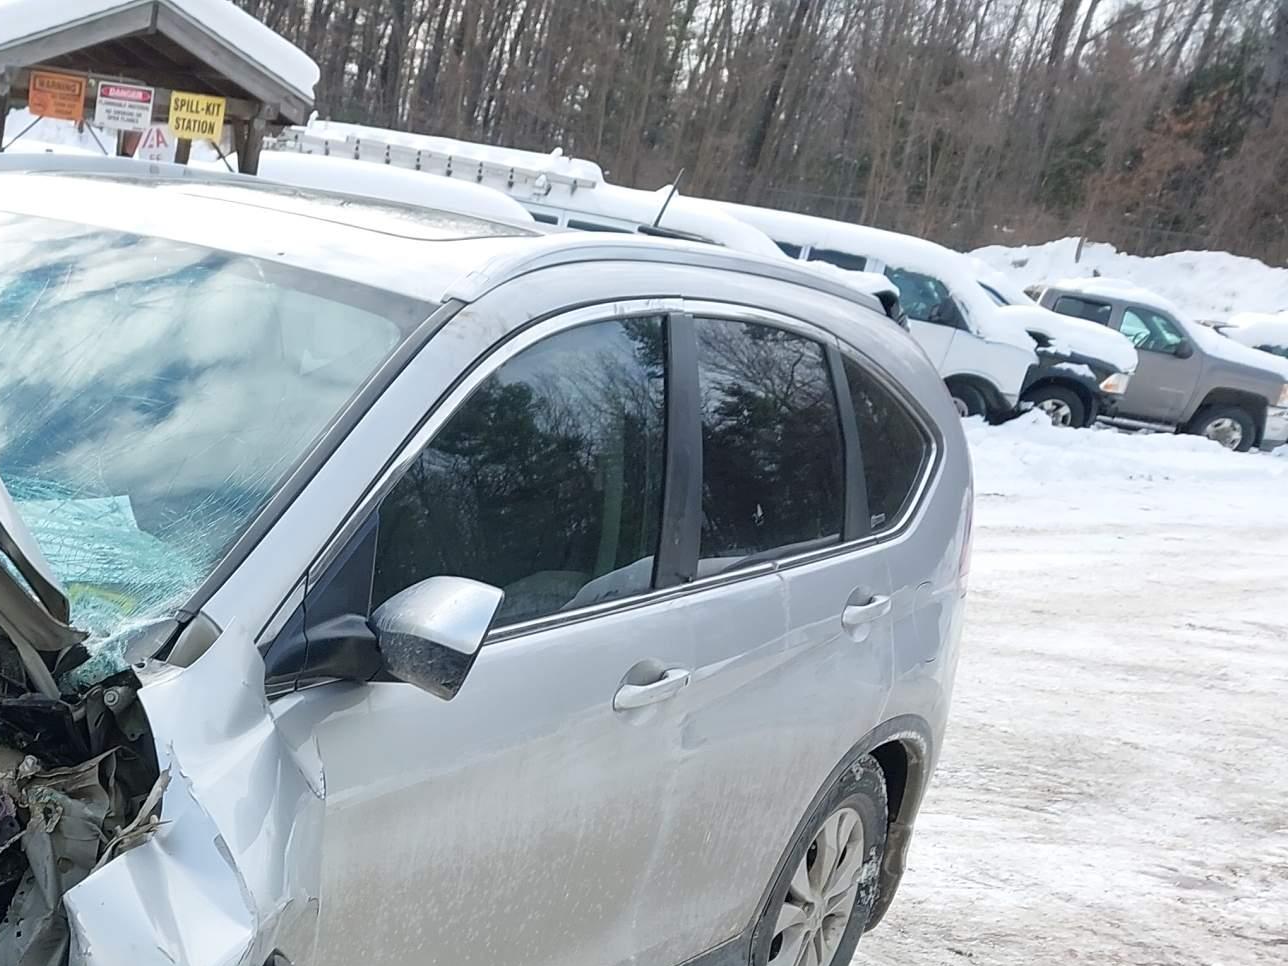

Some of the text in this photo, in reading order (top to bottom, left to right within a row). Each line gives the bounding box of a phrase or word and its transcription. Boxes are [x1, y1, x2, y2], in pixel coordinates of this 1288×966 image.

[38, 79, 77, 92] WARNING
[108, 86, 143, 99] DANGER
[174, 97, 221, 117] SPILL-KIT
[174, 117, 216, 134] STATION
